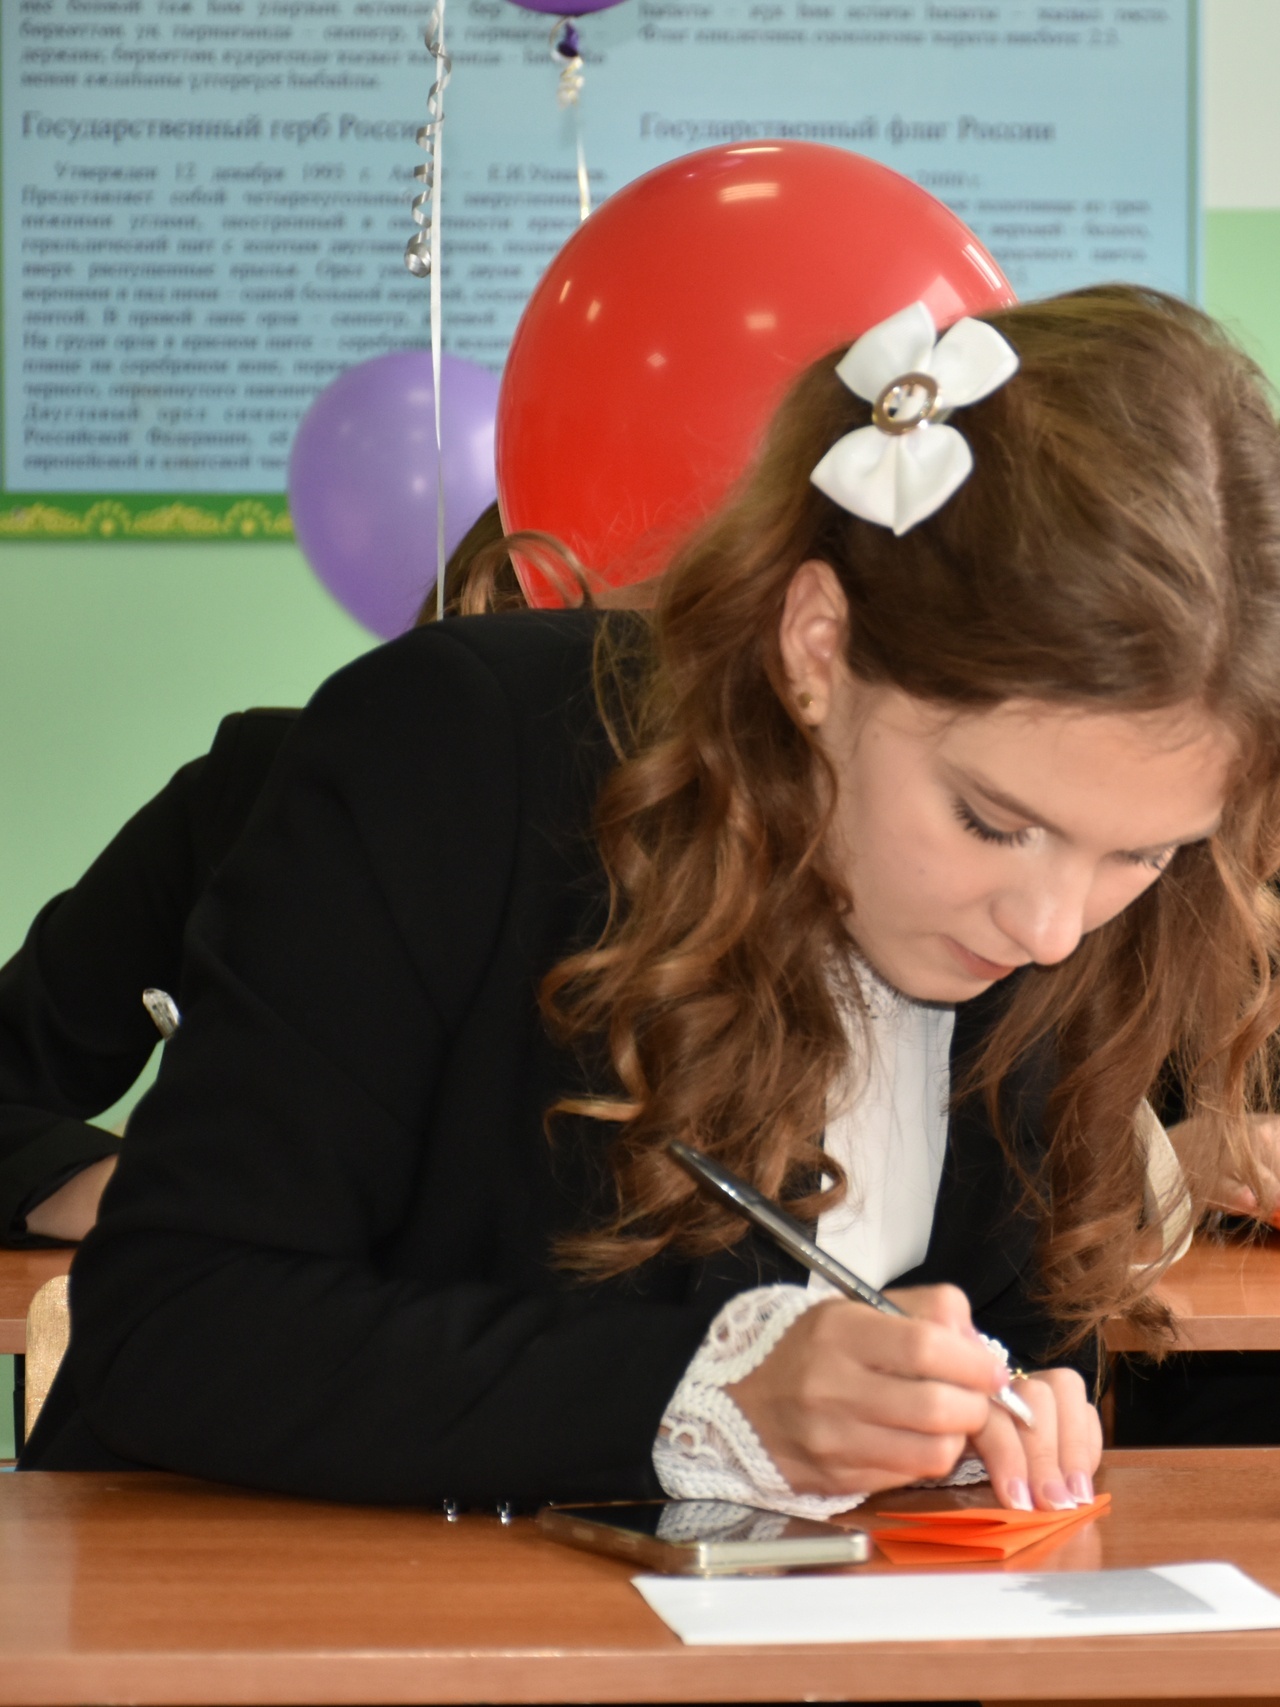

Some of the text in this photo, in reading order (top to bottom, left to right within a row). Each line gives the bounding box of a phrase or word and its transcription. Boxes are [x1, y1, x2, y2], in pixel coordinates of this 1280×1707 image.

[21, 110, 261, 144] Государственный
[269, 112, 331, 145] герб
[639, 112, 1057, 145] Государственный флаг России
